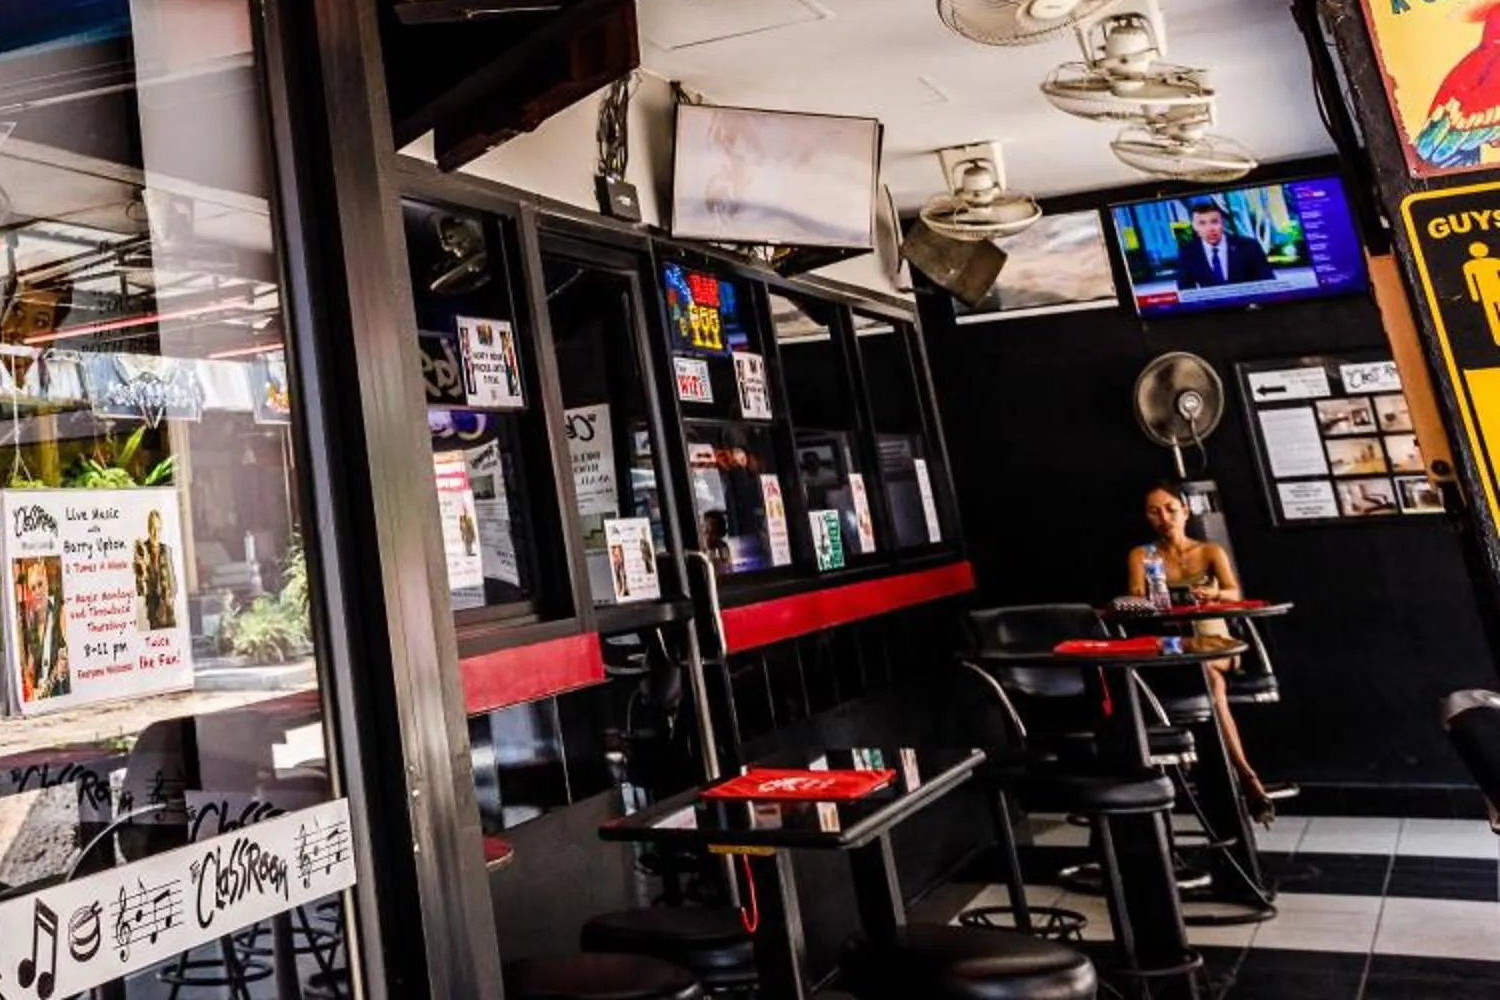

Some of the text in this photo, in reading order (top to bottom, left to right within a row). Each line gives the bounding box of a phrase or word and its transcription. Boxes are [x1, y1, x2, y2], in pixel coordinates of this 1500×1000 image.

[65, 507, 120, 521] Live Music
[64, 539, 93, 559] Barry
